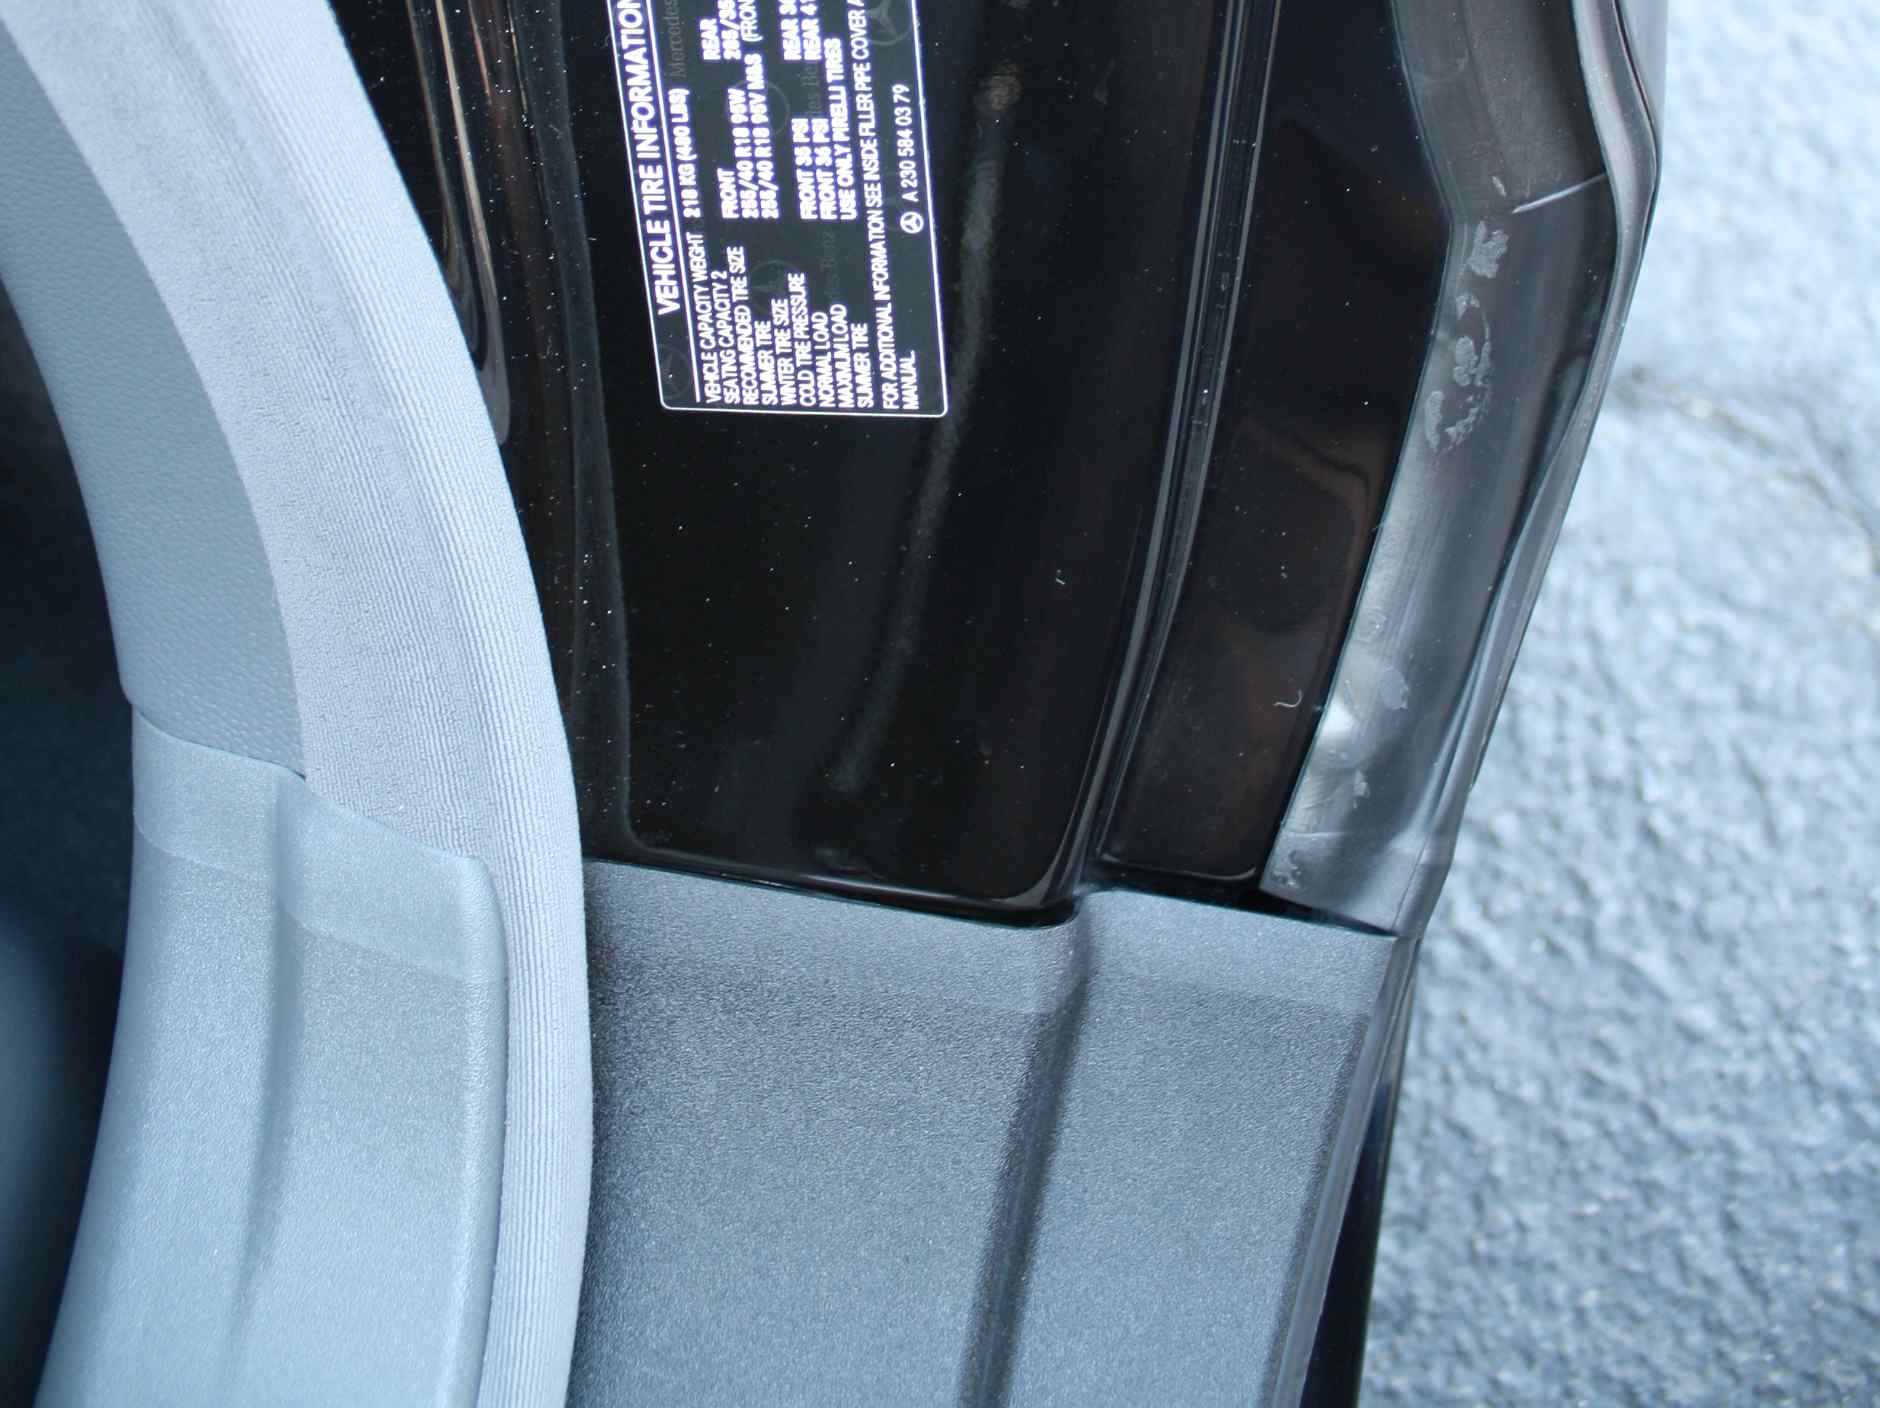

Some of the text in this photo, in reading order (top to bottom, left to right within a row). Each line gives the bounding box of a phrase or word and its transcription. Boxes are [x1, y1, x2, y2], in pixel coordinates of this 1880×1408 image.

[781, 18, 802, 60] REAR
[801, 18, 822, 60] REAR
[848, 10, 869, 60] COVER
[744, 53, 765, 90] M&S
[853, 62, 872, 91] PIPE
[668, 88, 689, 123] LBS)
[728, 88, 749, 124] 95W
[748, 92, 769, 124] 95V
[856, 93, 876, 137] FILLER
[732, 127, 752, 157] R18
[752, 127, 772, 158] R18
[791, 118, 810, 143] PSI
[811, 118, 830, 143] PSI
[892, 84, 919, 202] A 230 584 03 79
[678, 163, 696, 186] KG
[794, 146, 813, 166] 35
[814, 146, 833, 167] 36
[860, 139, 880, 181] INSIDE
[639, 165, 667, 215] TIRE
[736, 160, 759, 218] 255/40
[756, 160, 779, 219] 255/40
[796, 168, 818, 219] FRONT
[816, 168, 837, 220] FRONT
[864, 183, 883, 208] SEE
[700, 18, 759, 405] RECOMMENDED TIRE SIZE FRONT REAR
[823, 38, 874, 408] SUMMER TIRE USE ONLY PIRELLI TIRES
[646, 220, 680, 315] VEHICLE
[686, 232, 708, 282] WEIGHT
[867, 210, 891, 300] INFORMATION
[693, 284, 716, 349] CAPACITY
[754, 321, 772, 347] TIRE
[771, 299, 789, 326] SIZE
[811, 312, 830, 349] LOAD
[830, 304, 849, 342] LOAD
[711, 271, 740, 404] SEATING CAPACITY 2
[774, 328, 792, 354] TIRE
[788, 273, 816, 406] COLD TIRE PRESSURE
[876, 302, 898, 380] ADDITIONAL
[701, 352, 725, 403] VEHICLE
[757, 350, 779, 405] SUMMER
[777, 358, 798, 405] WINTER
[816, 352, 835, 407] NORMAL
[833, 343, 855, 408] MAXIMUM
[882, 382, 899, 409] FOR
[899, 350, 919, 409] MANUAL.
